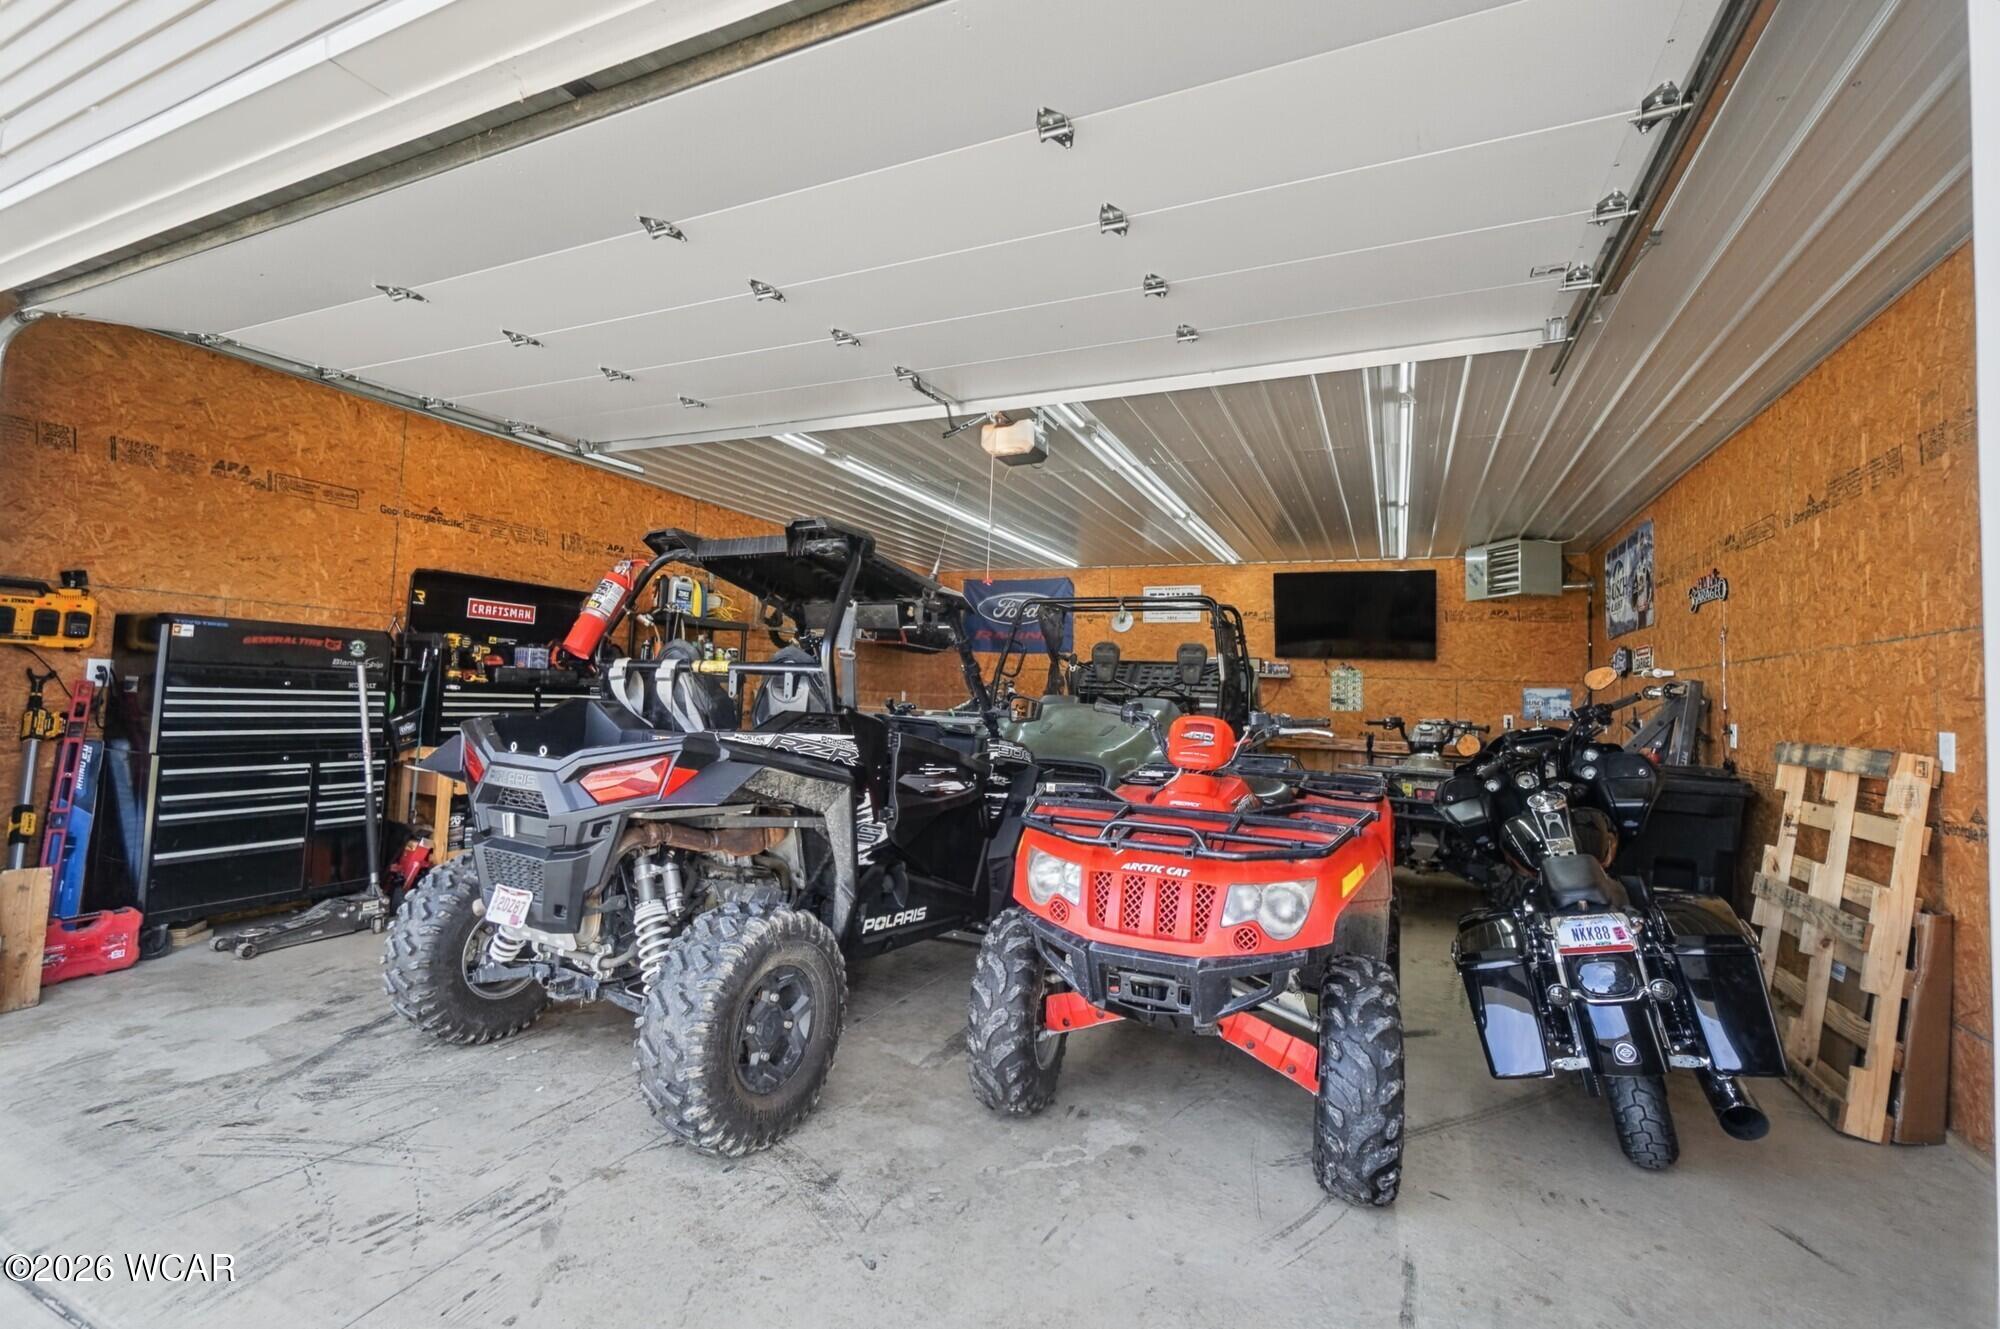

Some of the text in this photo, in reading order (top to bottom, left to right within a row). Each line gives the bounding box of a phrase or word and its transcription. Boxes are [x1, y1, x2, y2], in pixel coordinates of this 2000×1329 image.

[471, 602, 532, 620] CRAFTSMAN
[242, 635, 324, 647] GENERAL TIRE
[767, 733, 860, 766] RZR
[1120, 862, 1192, 878] ARCTIC CAT
[861, 906, 928, 935] POLARIS
[1571, 925, 1611, 942] NKK88
